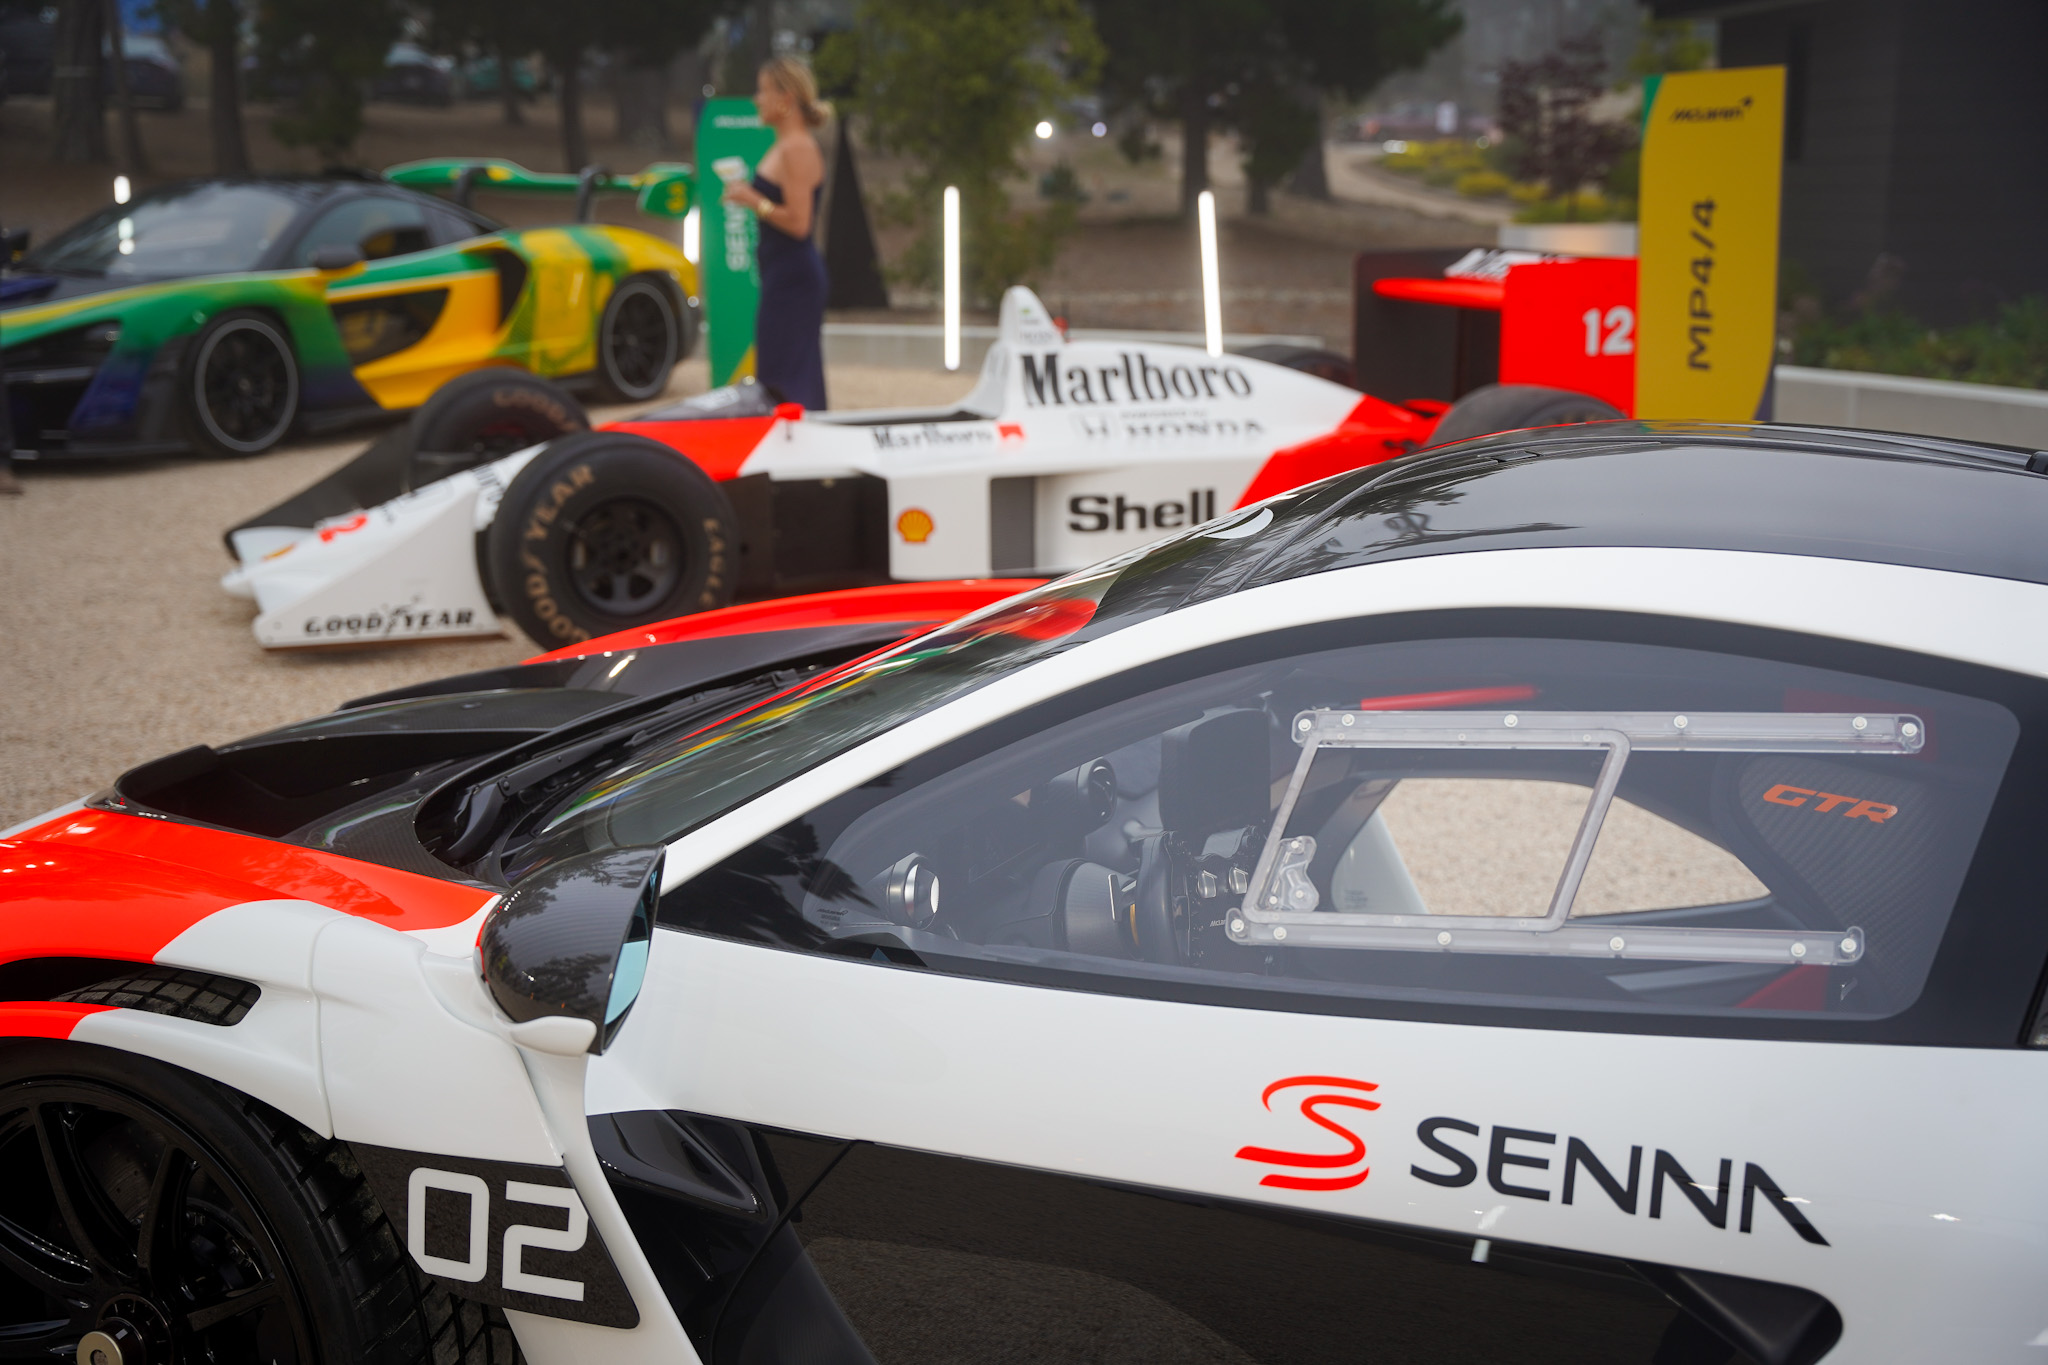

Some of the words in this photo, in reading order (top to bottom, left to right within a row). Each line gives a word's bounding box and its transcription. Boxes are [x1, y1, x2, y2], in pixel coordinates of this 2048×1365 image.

[1669, 105, 1747, 122] McLaren
[1687, 198, 1716, 371] MP4/4
[1582, 305, 1635, 357] 12
[1021, 352, 1253, 406] Marlboro
[872, 422, 994, 450] Marlboro
[1125, 418, 1264, 438] HONDA
[1069, 489, 1214, 533] Shell
[1763, 784, 1898, 823] GTR
[1410, 1116, 1831, 1247] SENNA
[408, 1167, 589, 1301] 02
